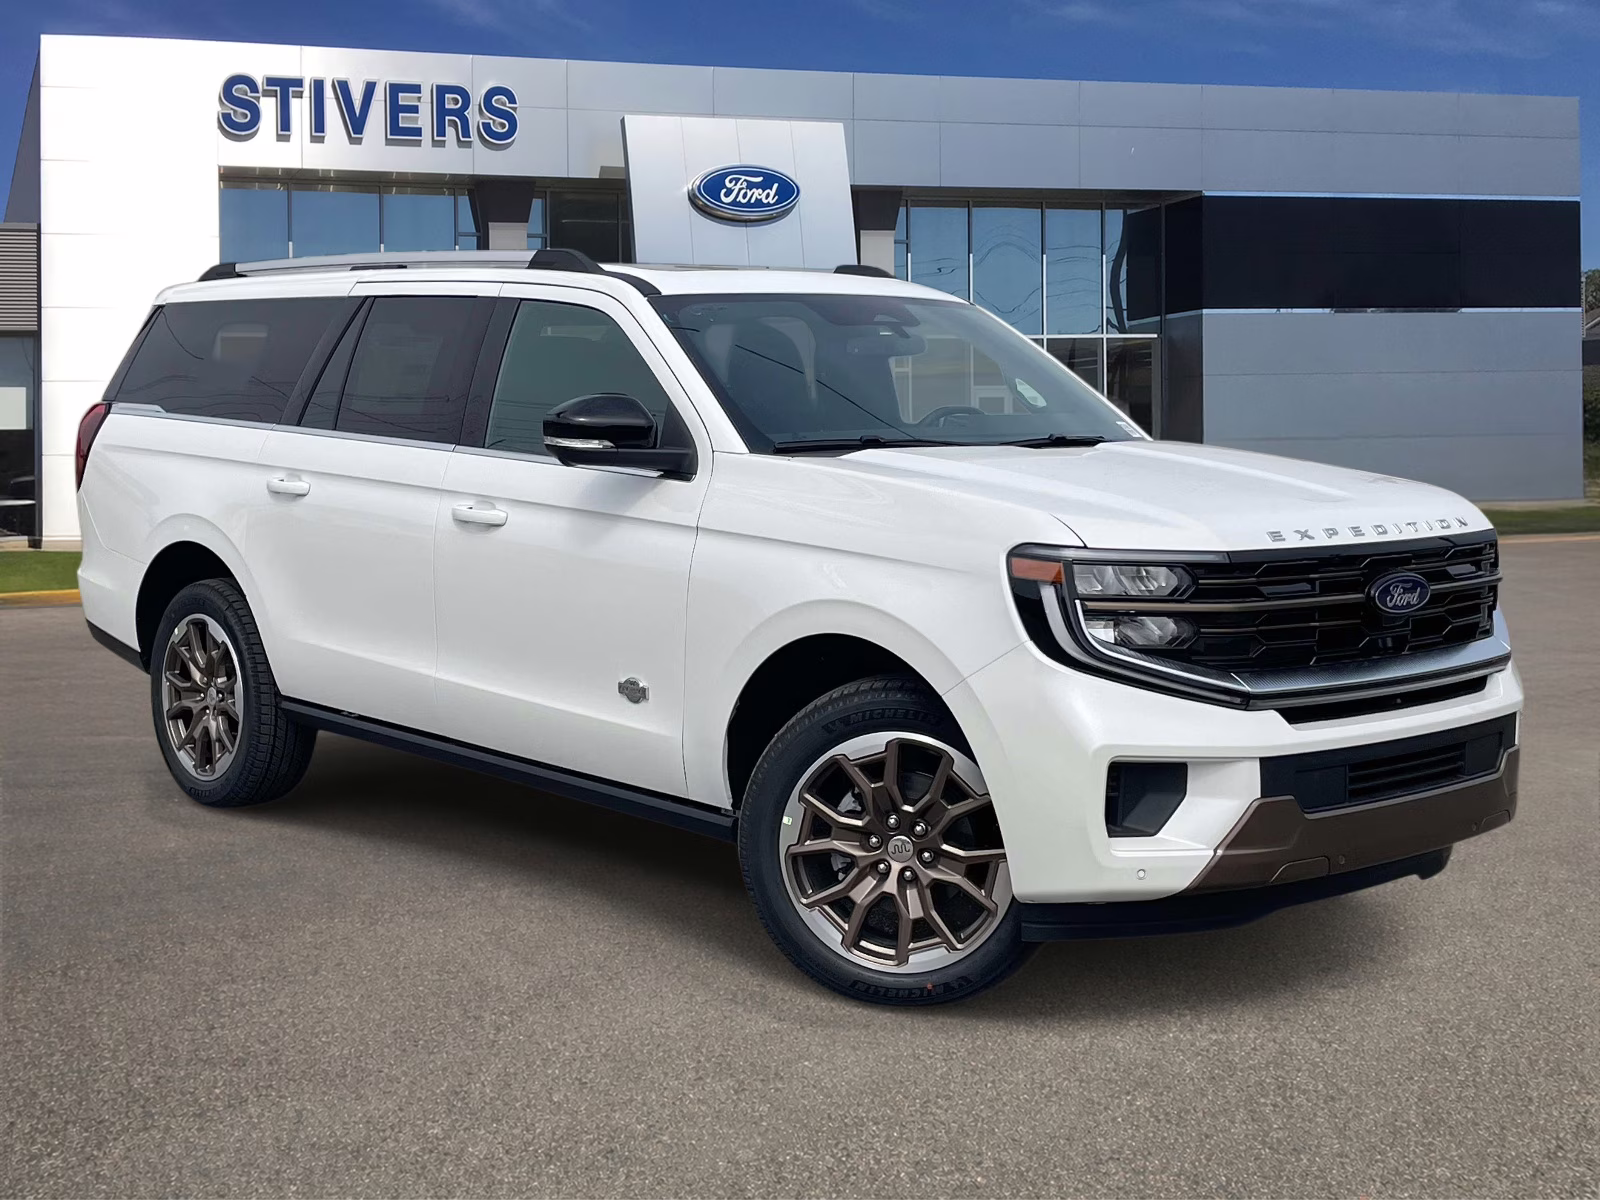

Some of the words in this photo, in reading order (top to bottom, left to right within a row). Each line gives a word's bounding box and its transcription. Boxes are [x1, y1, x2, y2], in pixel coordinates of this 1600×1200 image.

[218, 73, 519, 144] STIVERS
[720, 174, 779, 204] Ford
[1266, 516, 1469, 542] EXPEDITION
[1386, 582, 1421, 608] Ford
